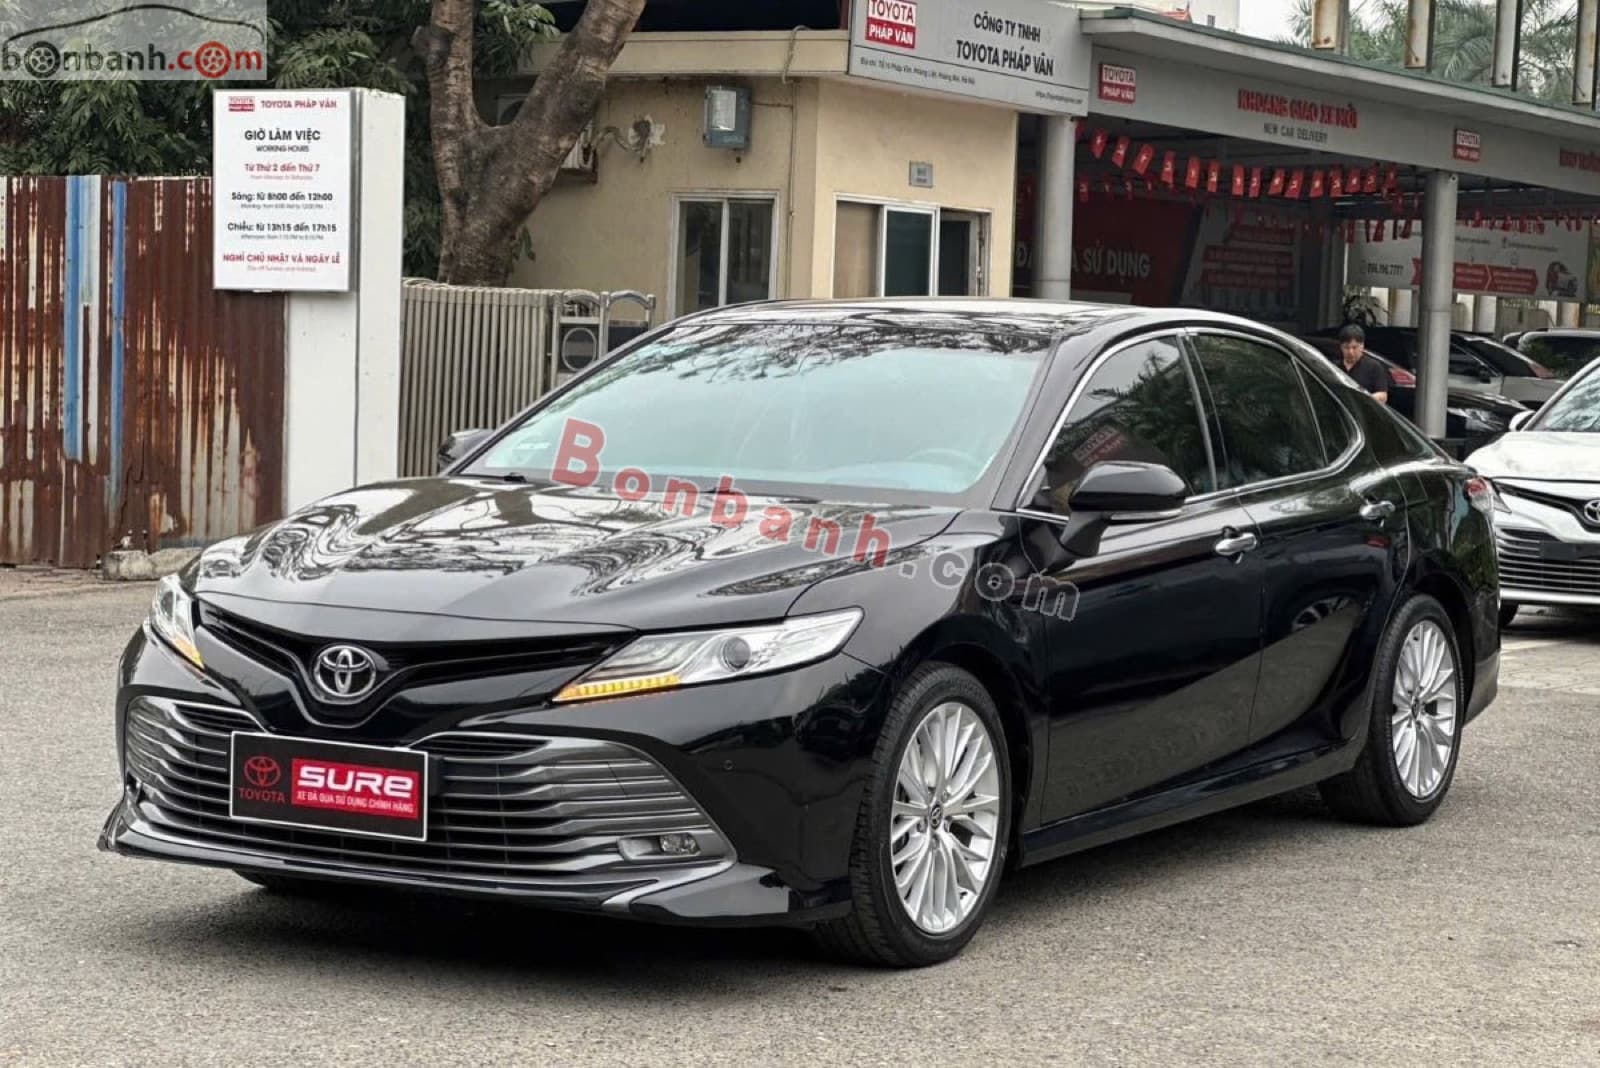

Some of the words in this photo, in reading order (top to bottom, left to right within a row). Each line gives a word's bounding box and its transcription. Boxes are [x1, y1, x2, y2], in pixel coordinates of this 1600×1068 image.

[869, 0, 914, 23] TOYOTA
[974, 10, 1003, 34] CÔNG
[1005, 20, 1016, 37] TY
[1018, 23, 1041, 42] TNHH
[869, 24, 893, 38] PHÁP
[895, 28, 914, 45] VÂN
[956, 40, 1000, 66] TOYOTA
[1002, 46, 1031, 72] PHÁP
[1033, 52, 1054, 77] VÂN
[1103, 67, 1134, 83] TOYOTA
[261, 100, 292, 109] TOYOTA
[244, 128, 266, 141] GIỜ
[269, 128, 292, 141] LÀM
[295, 128, 321, 143] VIỆC
[256, 145, 287, 153] WORKING
[272, 163, 279, 172] 2
[314, 163, 320, 172] 7
[232, 191, 255, 202] Sáng:
[267, 192, 288, 201] 8h00
[289, 191, 306, 201] đến
[308, 192, 333, 201] 12h00
[267, 223, 291, 232] 13h15
[293, 221, 310, 232] đến
[312, 223, 337, 232] 17h15
[239, 787, 286, 804] TOYOTA
[297, 790, 307, 801] XE
[319, 793, 334, 803] QUA
